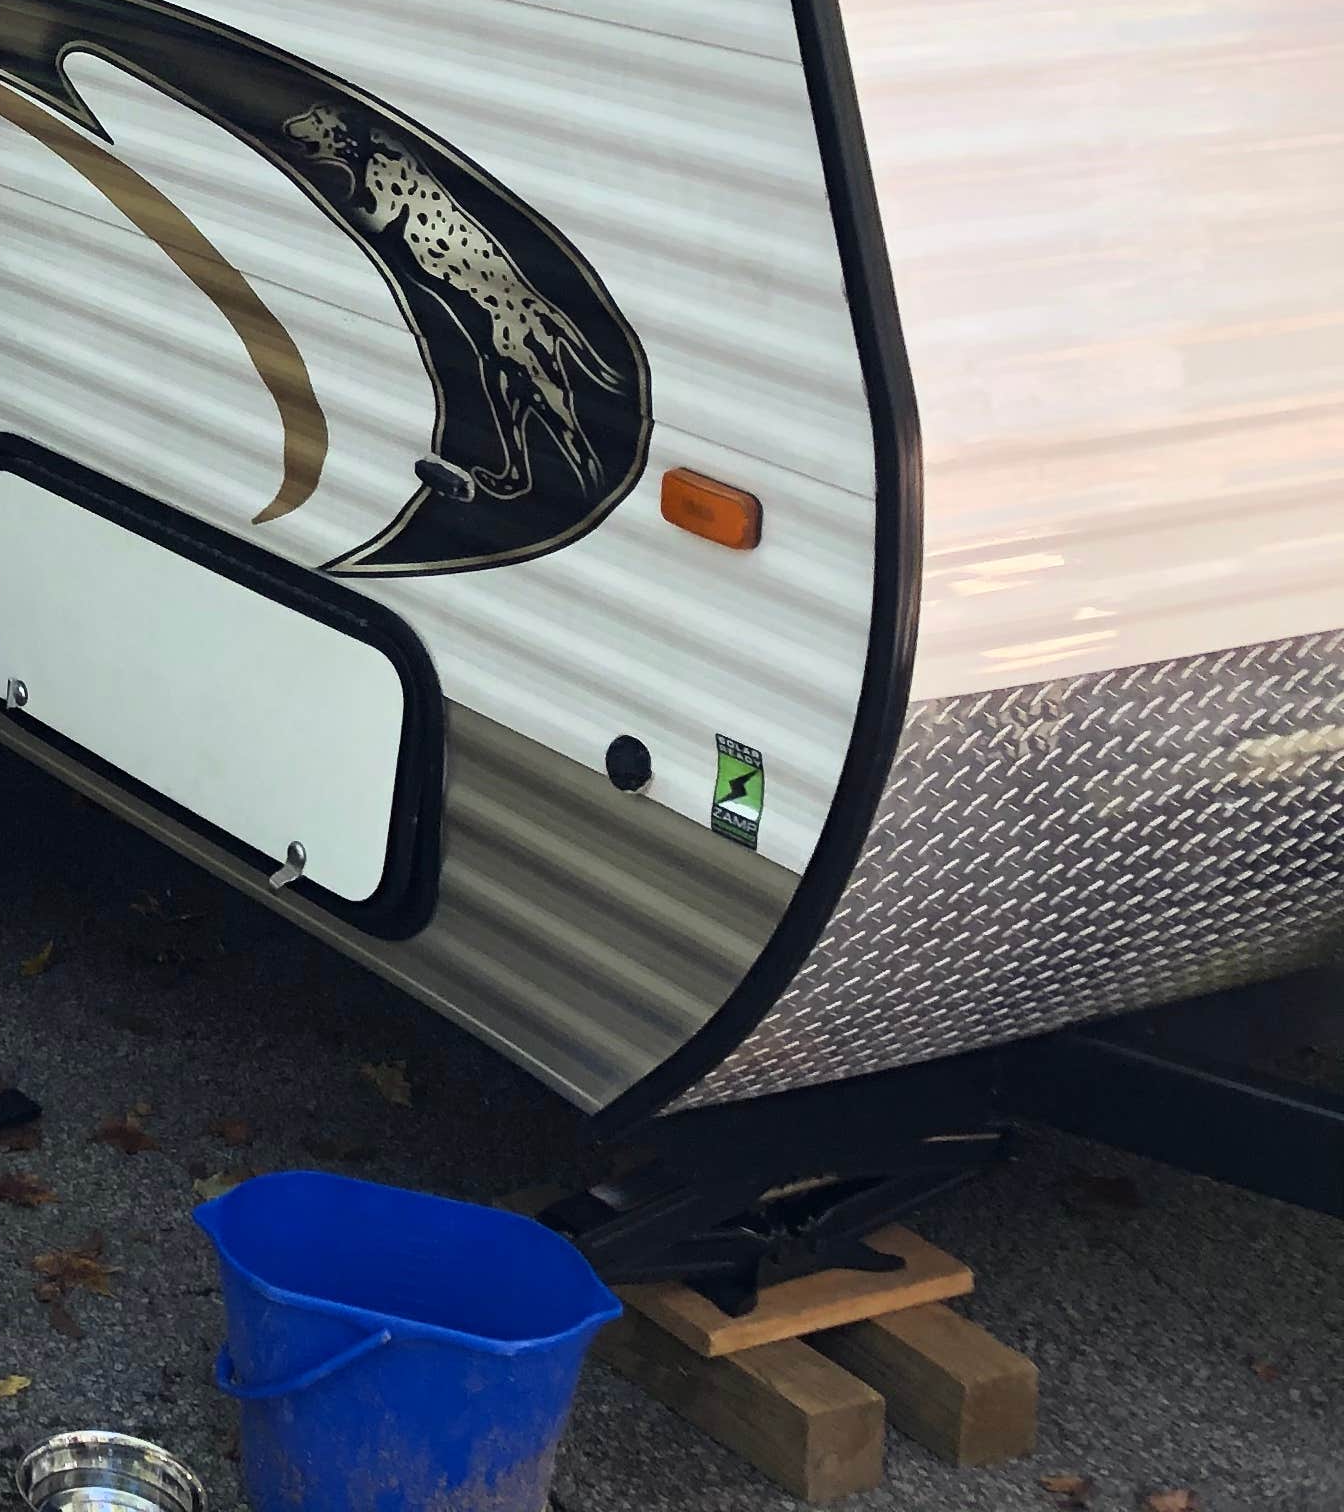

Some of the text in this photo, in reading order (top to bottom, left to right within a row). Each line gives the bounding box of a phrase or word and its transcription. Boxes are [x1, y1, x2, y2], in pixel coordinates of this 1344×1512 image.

[718, 736, 761, 759] SOLAR
[718, 745, 762, 768] READY
[713, 807, 758, 832] ZAMP
